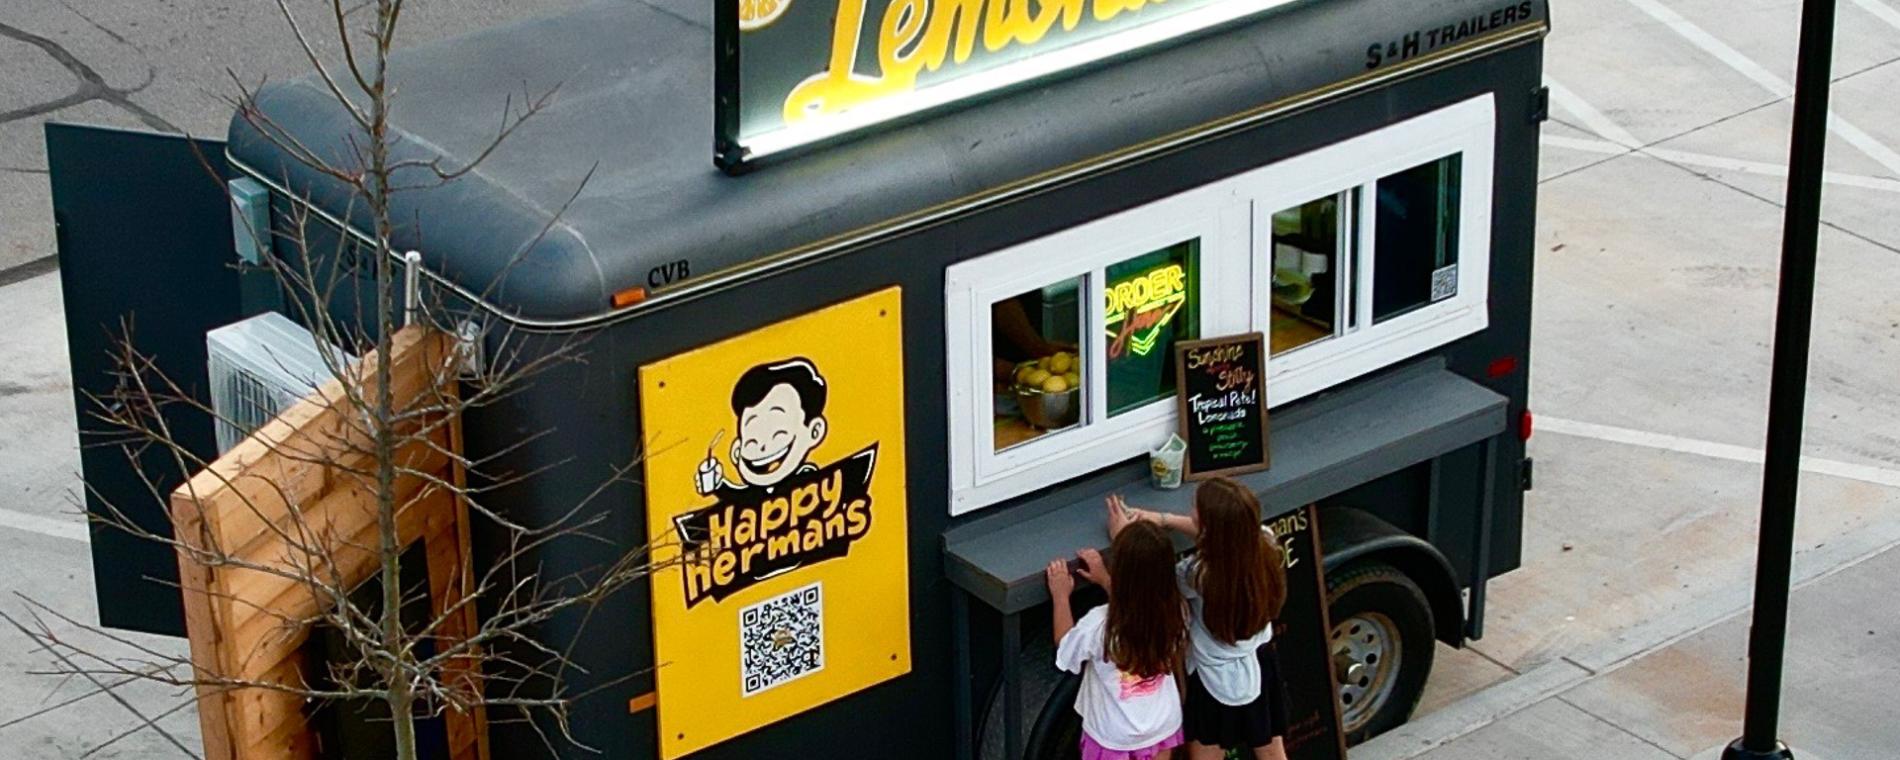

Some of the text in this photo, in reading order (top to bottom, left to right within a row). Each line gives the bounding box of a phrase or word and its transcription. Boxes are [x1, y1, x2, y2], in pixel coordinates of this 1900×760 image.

[1365, 43, 1382, 69] S
[1402, 31, 1420, 59] H
[1426, 1, 1532, 48] TRAILERS
[647, 258, 690, 288] CVB
[1105, 265, 1186, 316] ORDER
[709, 468, 843, 549] Happy
